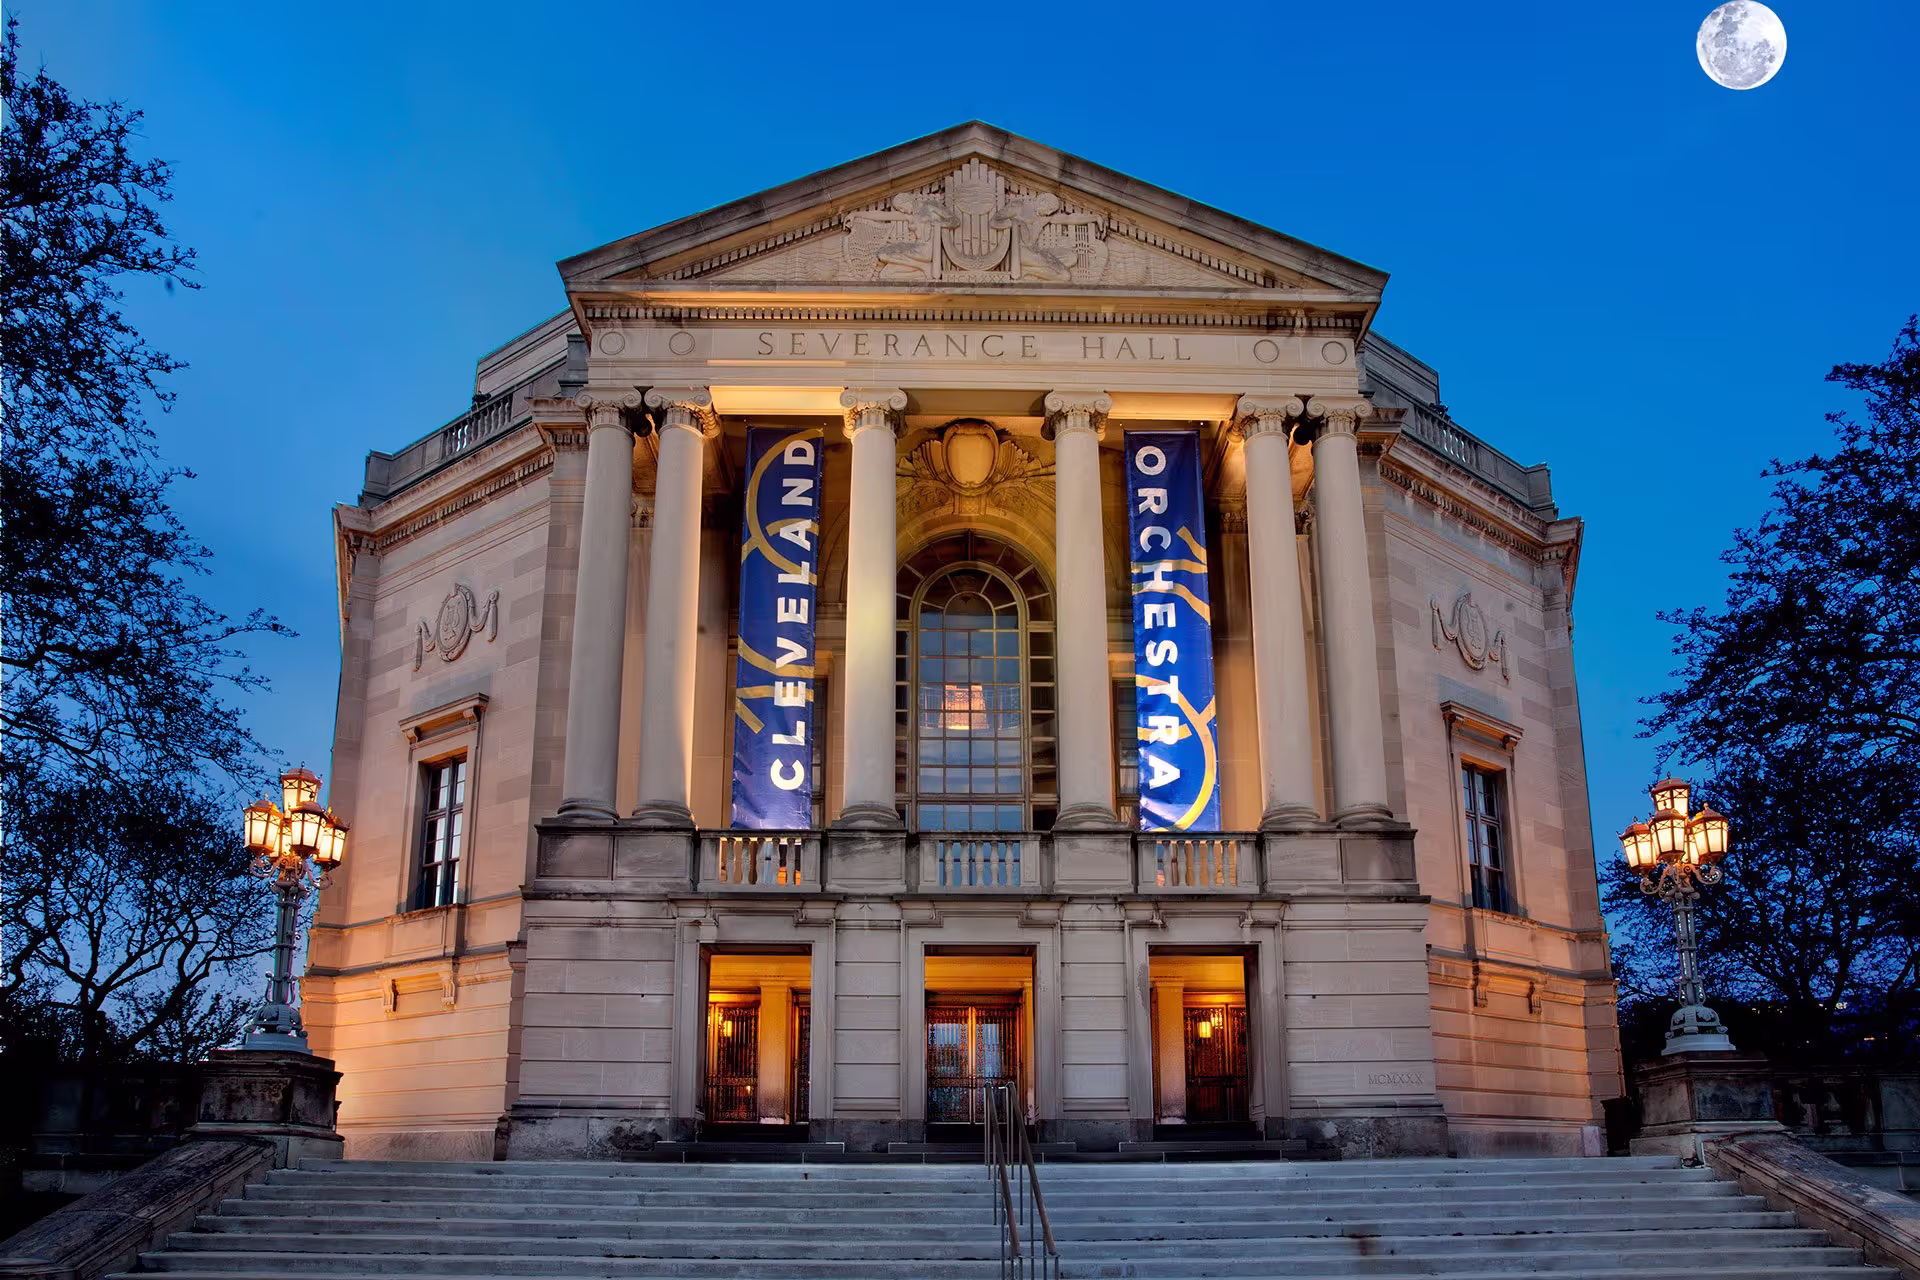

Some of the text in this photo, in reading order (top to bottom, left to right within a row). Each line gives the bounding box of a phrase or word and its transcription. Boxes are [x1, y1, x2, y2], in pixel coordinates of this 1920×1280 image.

[757, 331, 1191, 360] SEVERANCE HALL
[770, 439, 816, 791] CLEVELAND
[1135, 444, 1181, 791] ORCHESTRA
[1369, 1073, 1424, 1085] MCMXXX
